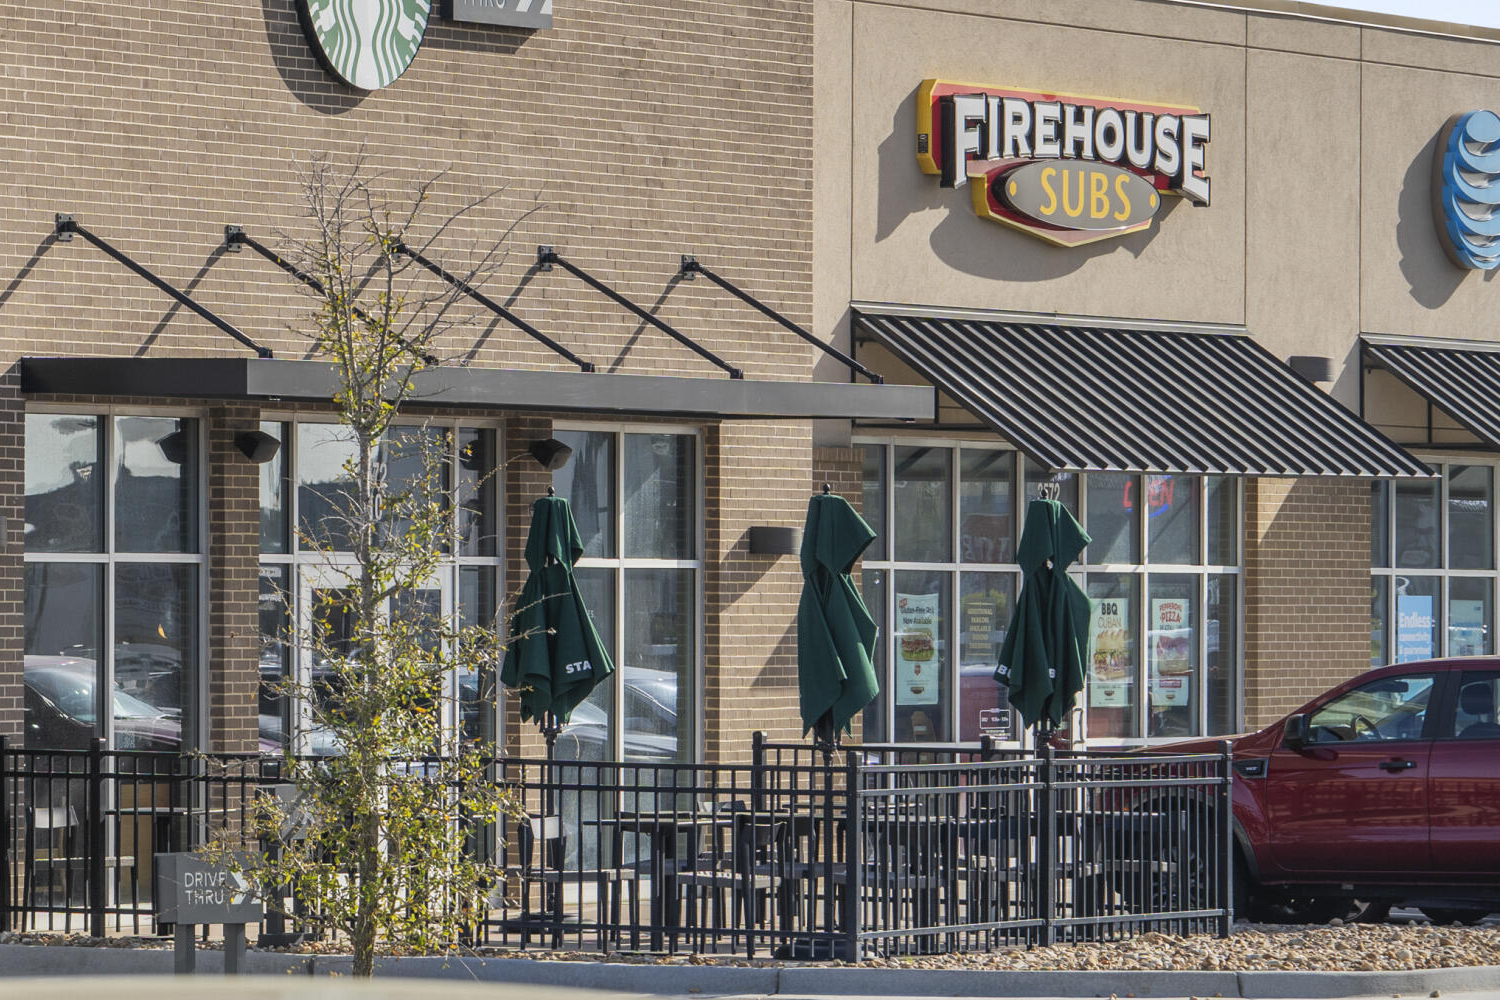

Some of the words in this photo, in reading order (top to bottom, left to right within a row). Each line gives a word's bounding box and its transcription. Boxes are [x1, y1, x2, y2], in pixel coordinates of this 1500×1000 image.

[943, 92, 1211, 207] FIREHOUSE
[1040, 167, 1132, 222] SUBS
[1123, 479, 1175, 507] OEN
[1101, 602, 1118, 616] BBQ
[1098, 616, 1123, 629] CUBAN
[1161, 611, 1181, 624] PIZZA
[184, 871, 227, 888] DRIVE
[184, 889, 224, 905] THRU
